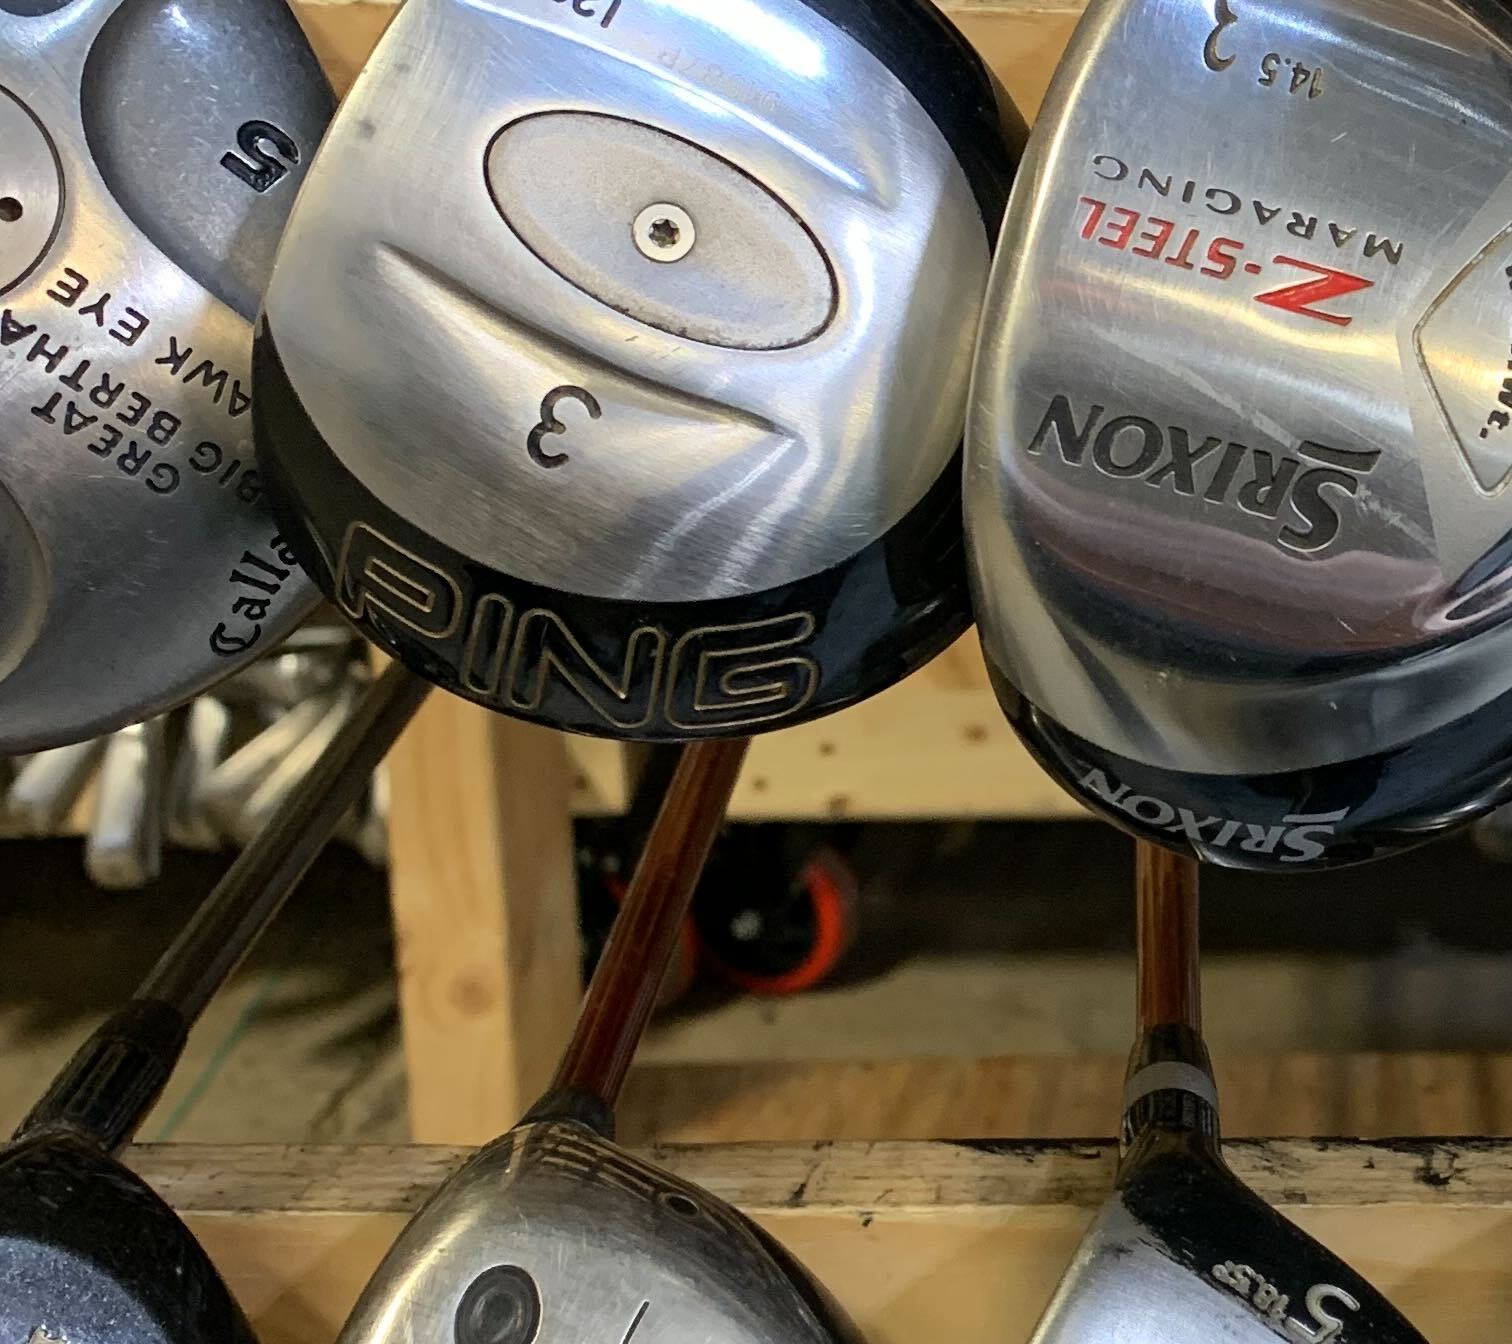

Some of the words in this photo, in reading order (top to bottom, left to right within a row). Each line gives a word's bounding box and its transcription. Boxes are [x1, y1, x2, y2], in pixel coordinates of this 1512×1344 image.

[1257, 50, 1325, 101] 14.5
[220, 120, 301, 194] 5
[1092, 153, 1405, 265] MARAGING
[46, 267, 149, 347] EYE
[1079, 197, 1375, 328] Z-STEEL
[0, 309, 182, 448] BERTHA
[157, 335, 252, 419] AWK
[526, 385, 602, 468] 3
[31, 382, 181, 496] GREAT
[1029, 394, 1381, 554] SRIXON
[208, 530, 299, 656] Calla
[337, 520, 819, 729] PING
[1080, 765, 1346, 863] SRIXON
